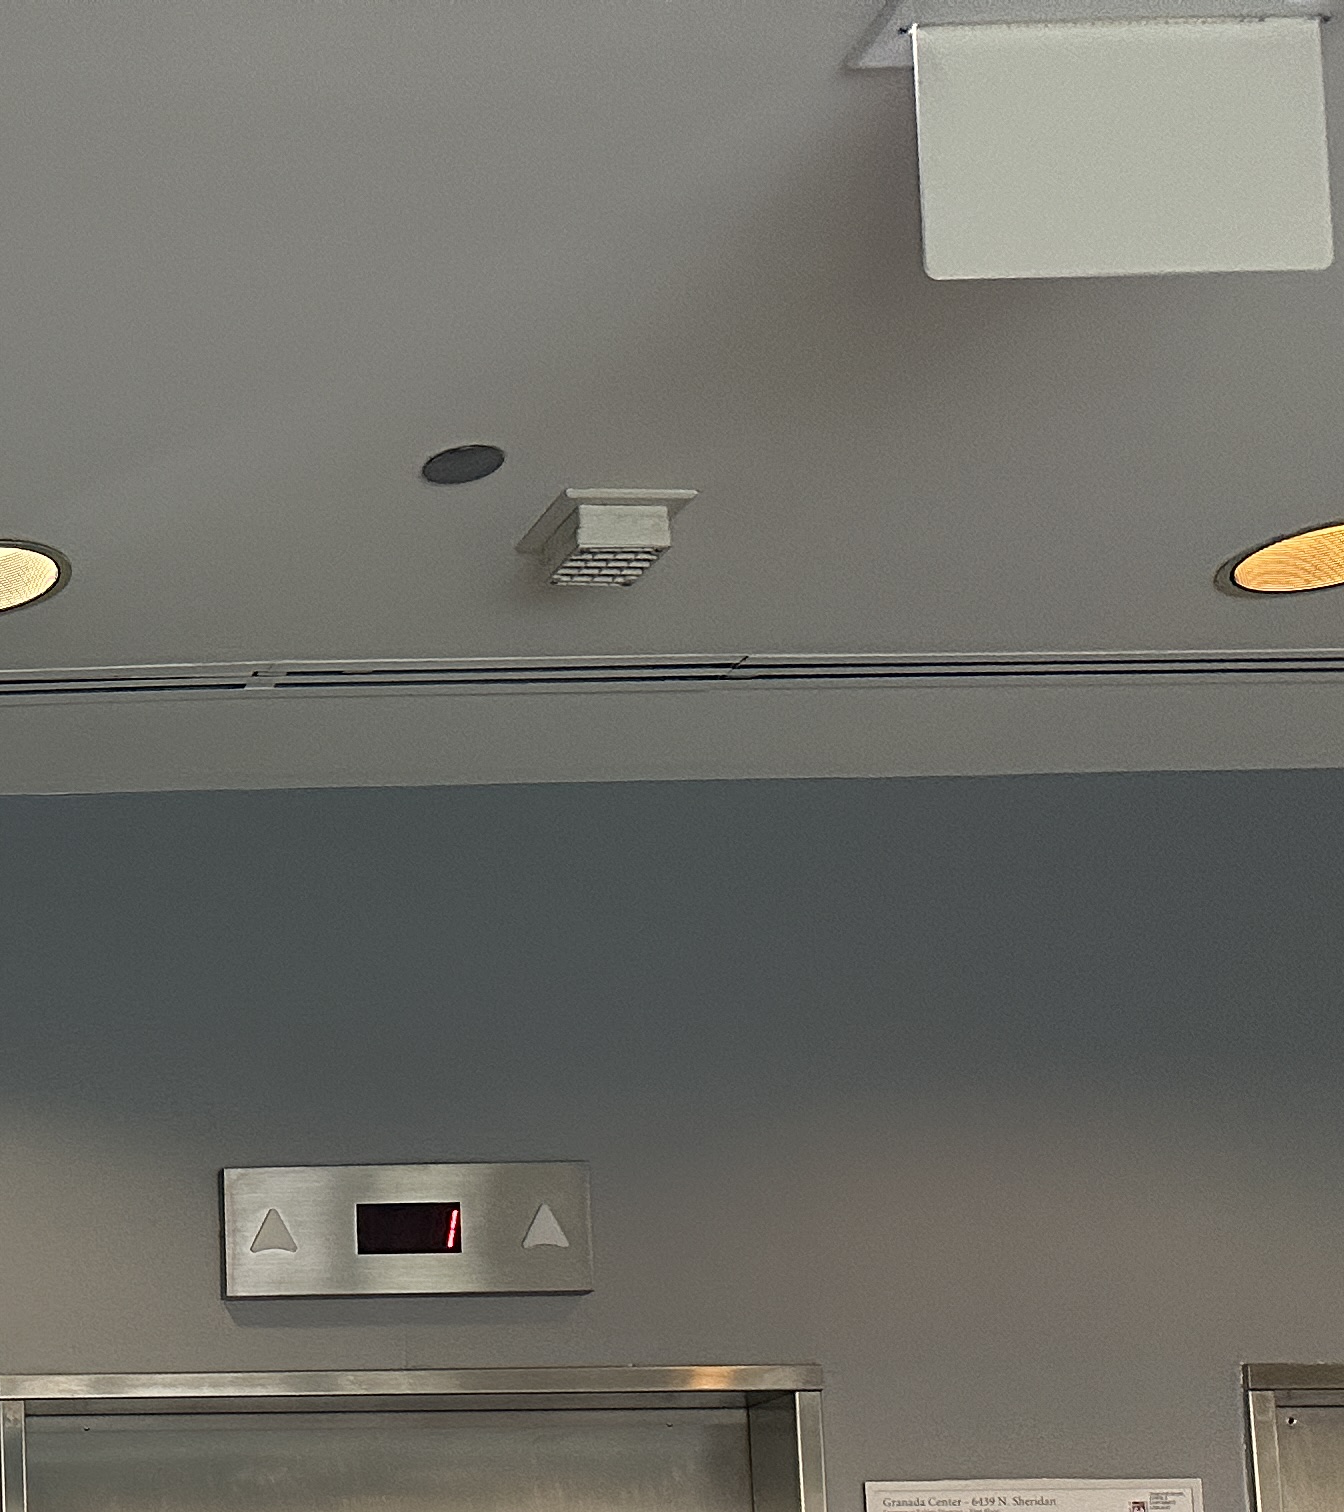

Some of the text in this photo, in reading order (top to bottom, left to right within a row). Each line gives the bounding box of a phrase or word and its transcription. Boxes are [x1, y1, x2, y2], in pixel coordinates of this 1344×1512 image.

[447, 1209, 459, 1248] 1
[882, 1497, 926, 1507] Granada
[928, 1497, 962, 1507] Center
[1012, 1496, 1056, 1507] Sheridan
